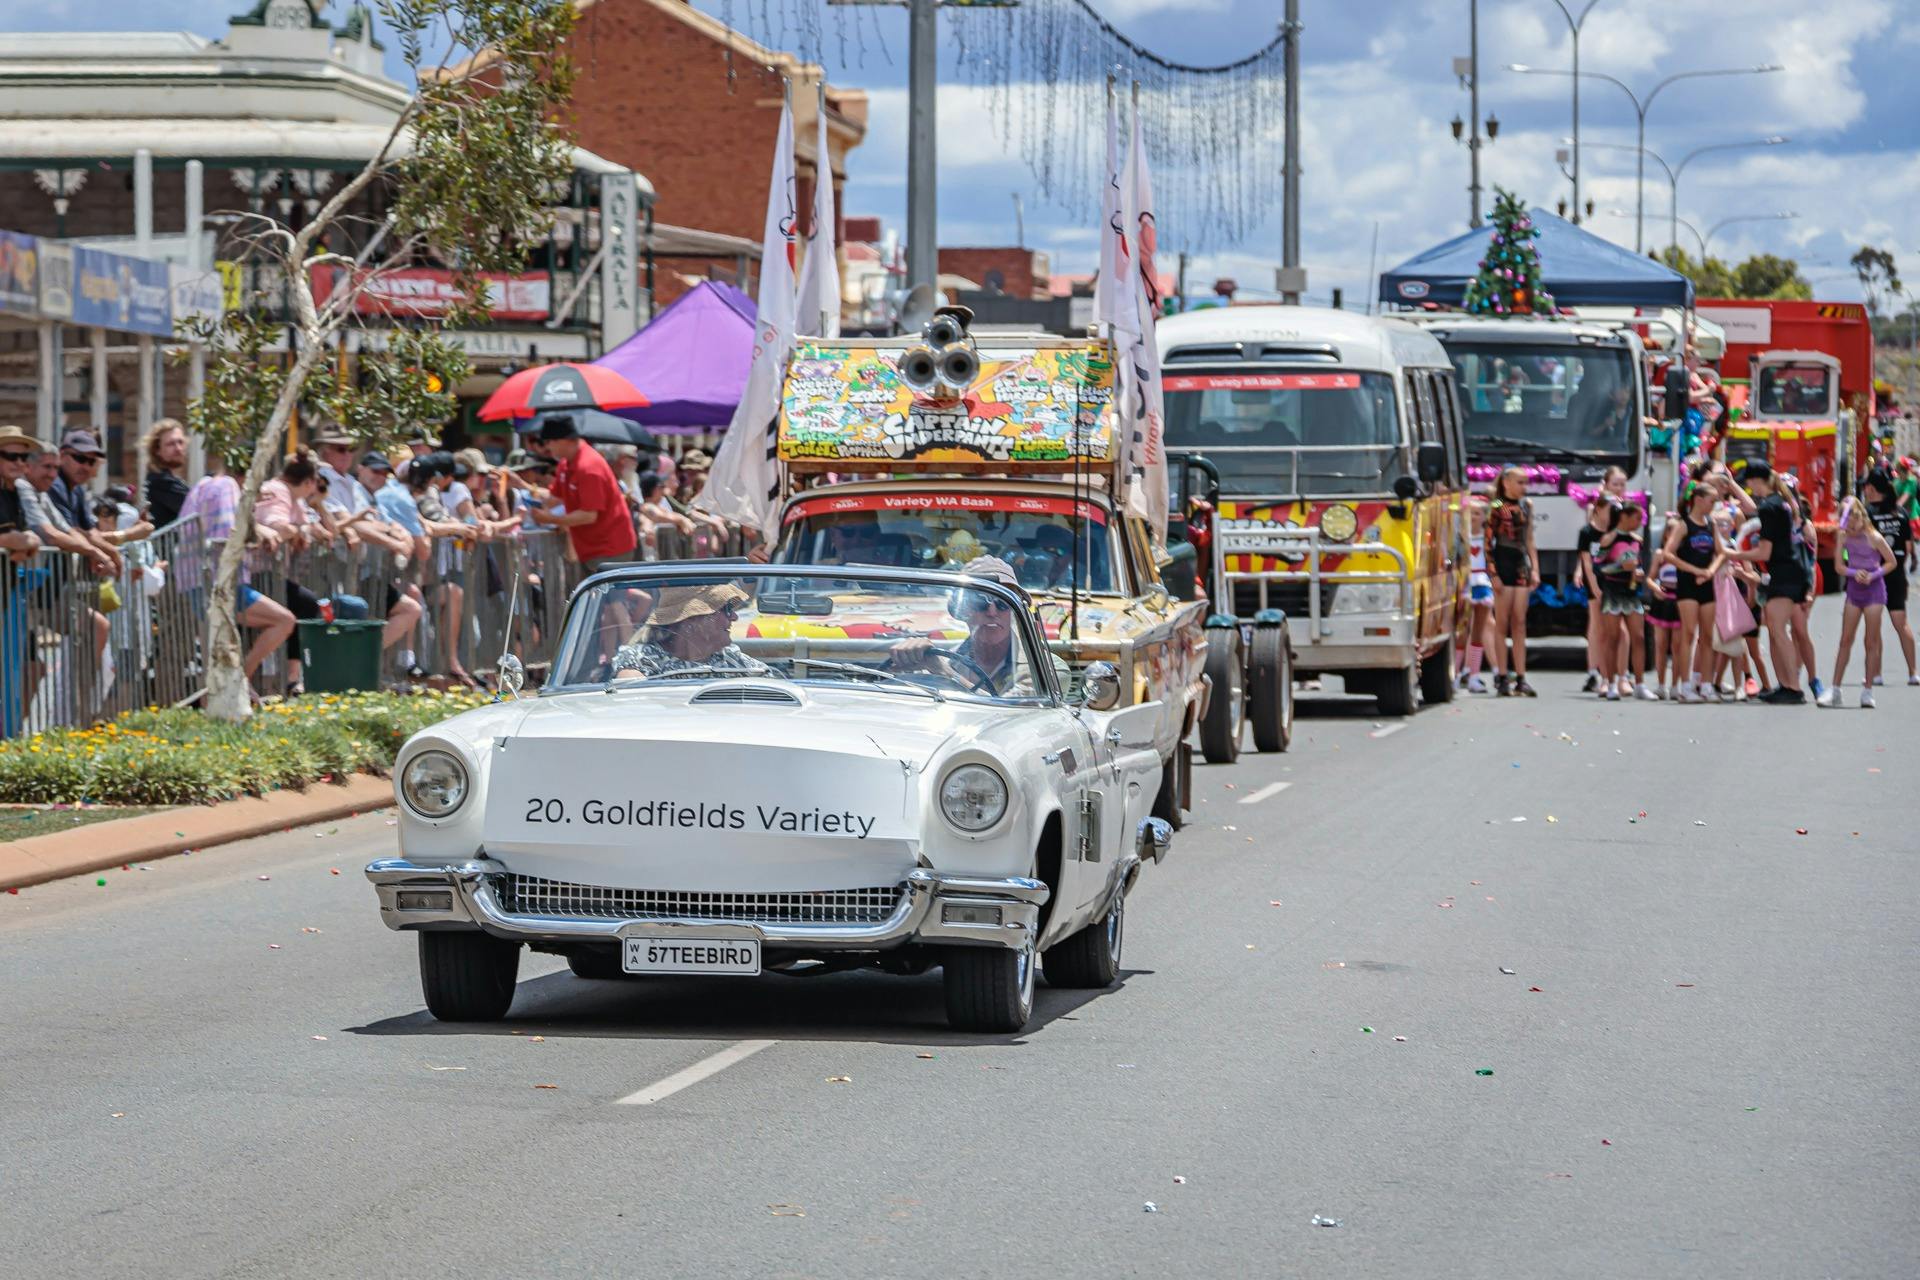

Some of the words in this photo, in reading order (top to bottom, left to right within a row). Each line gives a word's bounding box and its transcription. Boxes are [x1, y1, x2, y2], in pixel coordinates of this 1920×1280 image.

[882, 427, 1015, 460] UNDERPANTS
[884, 497, 935, 508] Variety
[936, 497, 960, 507] WA
[960, 497, 994, 508] Bash
[525, 798, 571, 824] 20.
[582, 799, 746, 829] Goldfields
[756, 804, 876, 840] Variety
[647, 946, 753, 965] 57TEEBIRD
